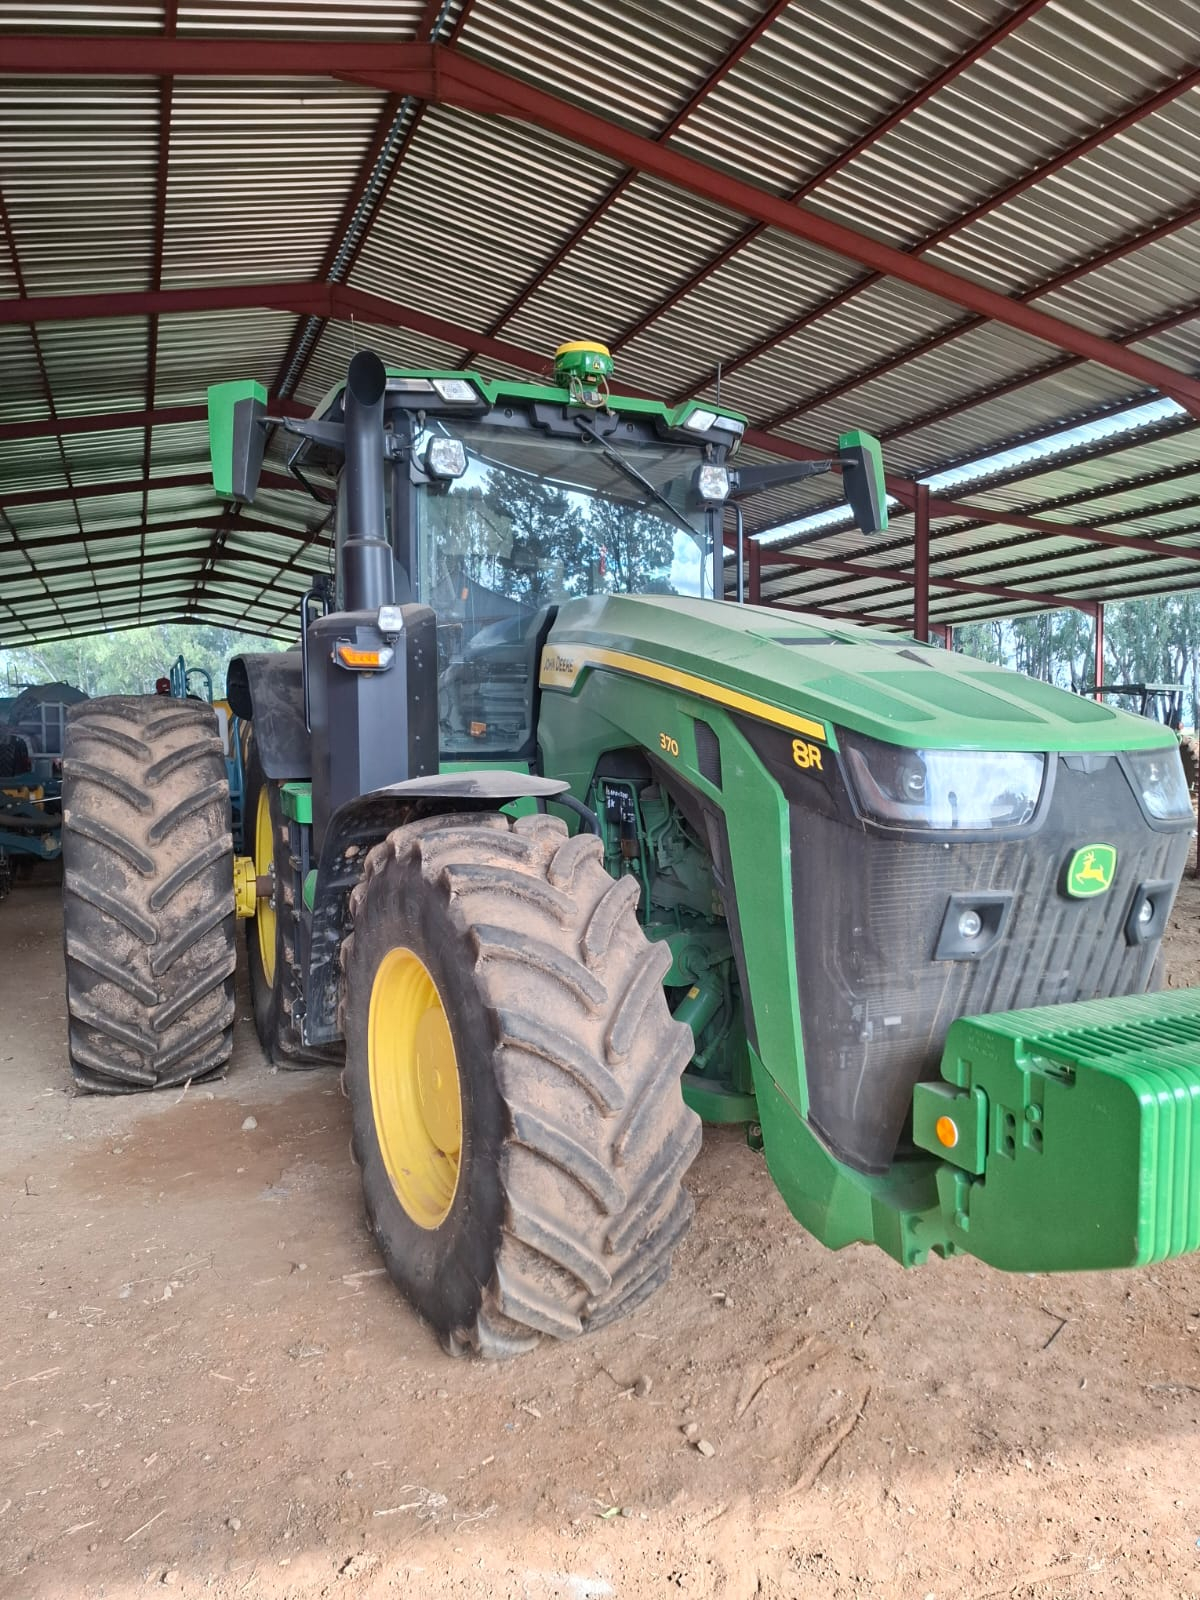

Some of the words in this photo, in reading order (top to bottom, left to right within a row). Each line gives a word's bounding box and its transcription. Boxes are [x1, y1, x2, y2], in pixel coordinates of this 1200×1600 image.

[543, 657, 555, 671] JOHN
[556, 656, 574, 673] DEERE
[659, 733, 679, 756] 370
[792, 739, 823, 770] 8R
